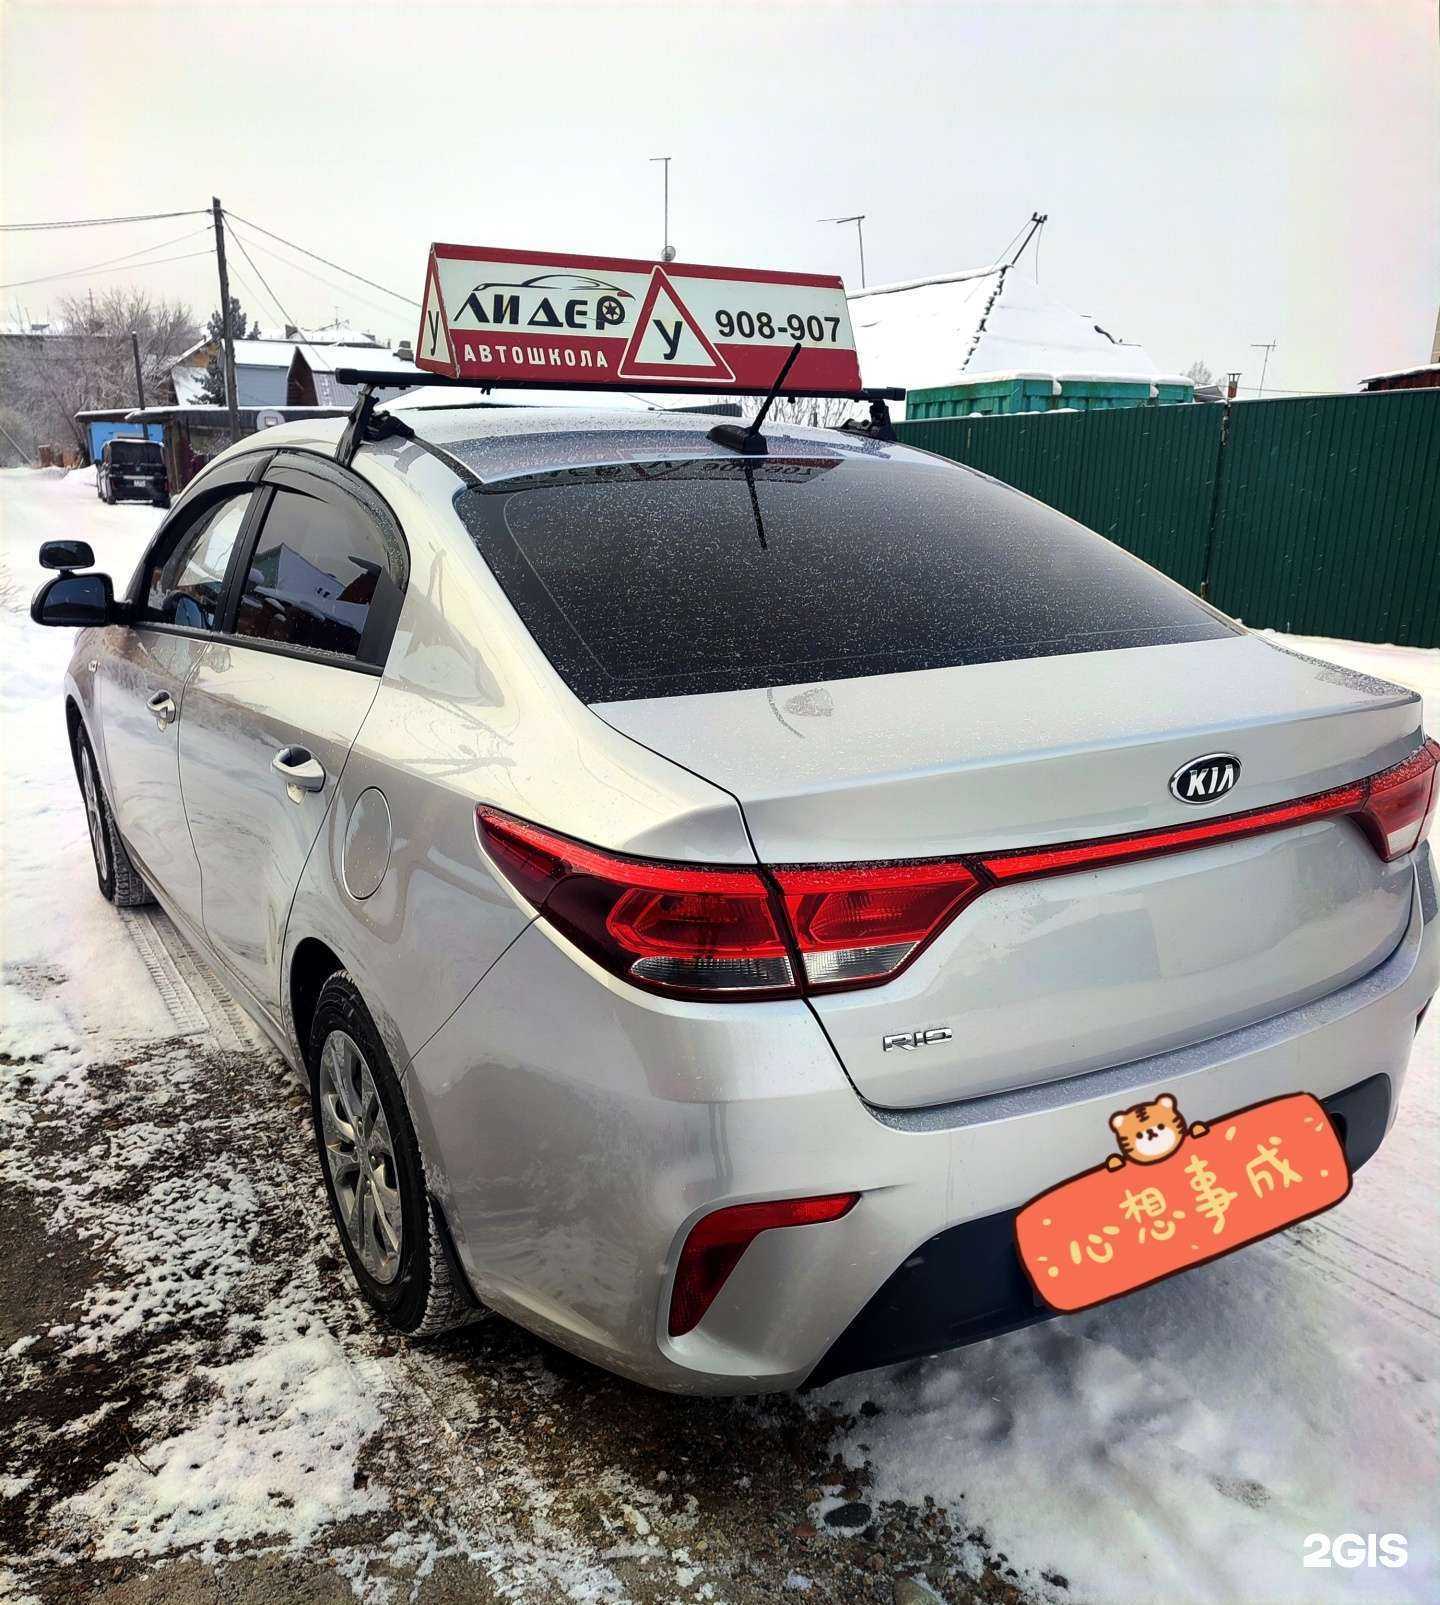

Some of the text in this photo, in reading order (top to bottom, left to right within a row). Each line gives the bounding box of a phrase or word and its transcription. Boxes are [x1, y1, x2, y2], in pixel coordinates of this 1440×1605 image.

[453, 292, 626, 330] ЛИДЕР
[714, 309, 841, 342] 908-907
[464, 344, 608, 368] АВТОШКОЛА
[1186, 763, 1234, 797] KIA
[883, 1027, 952, 1052] RIO
